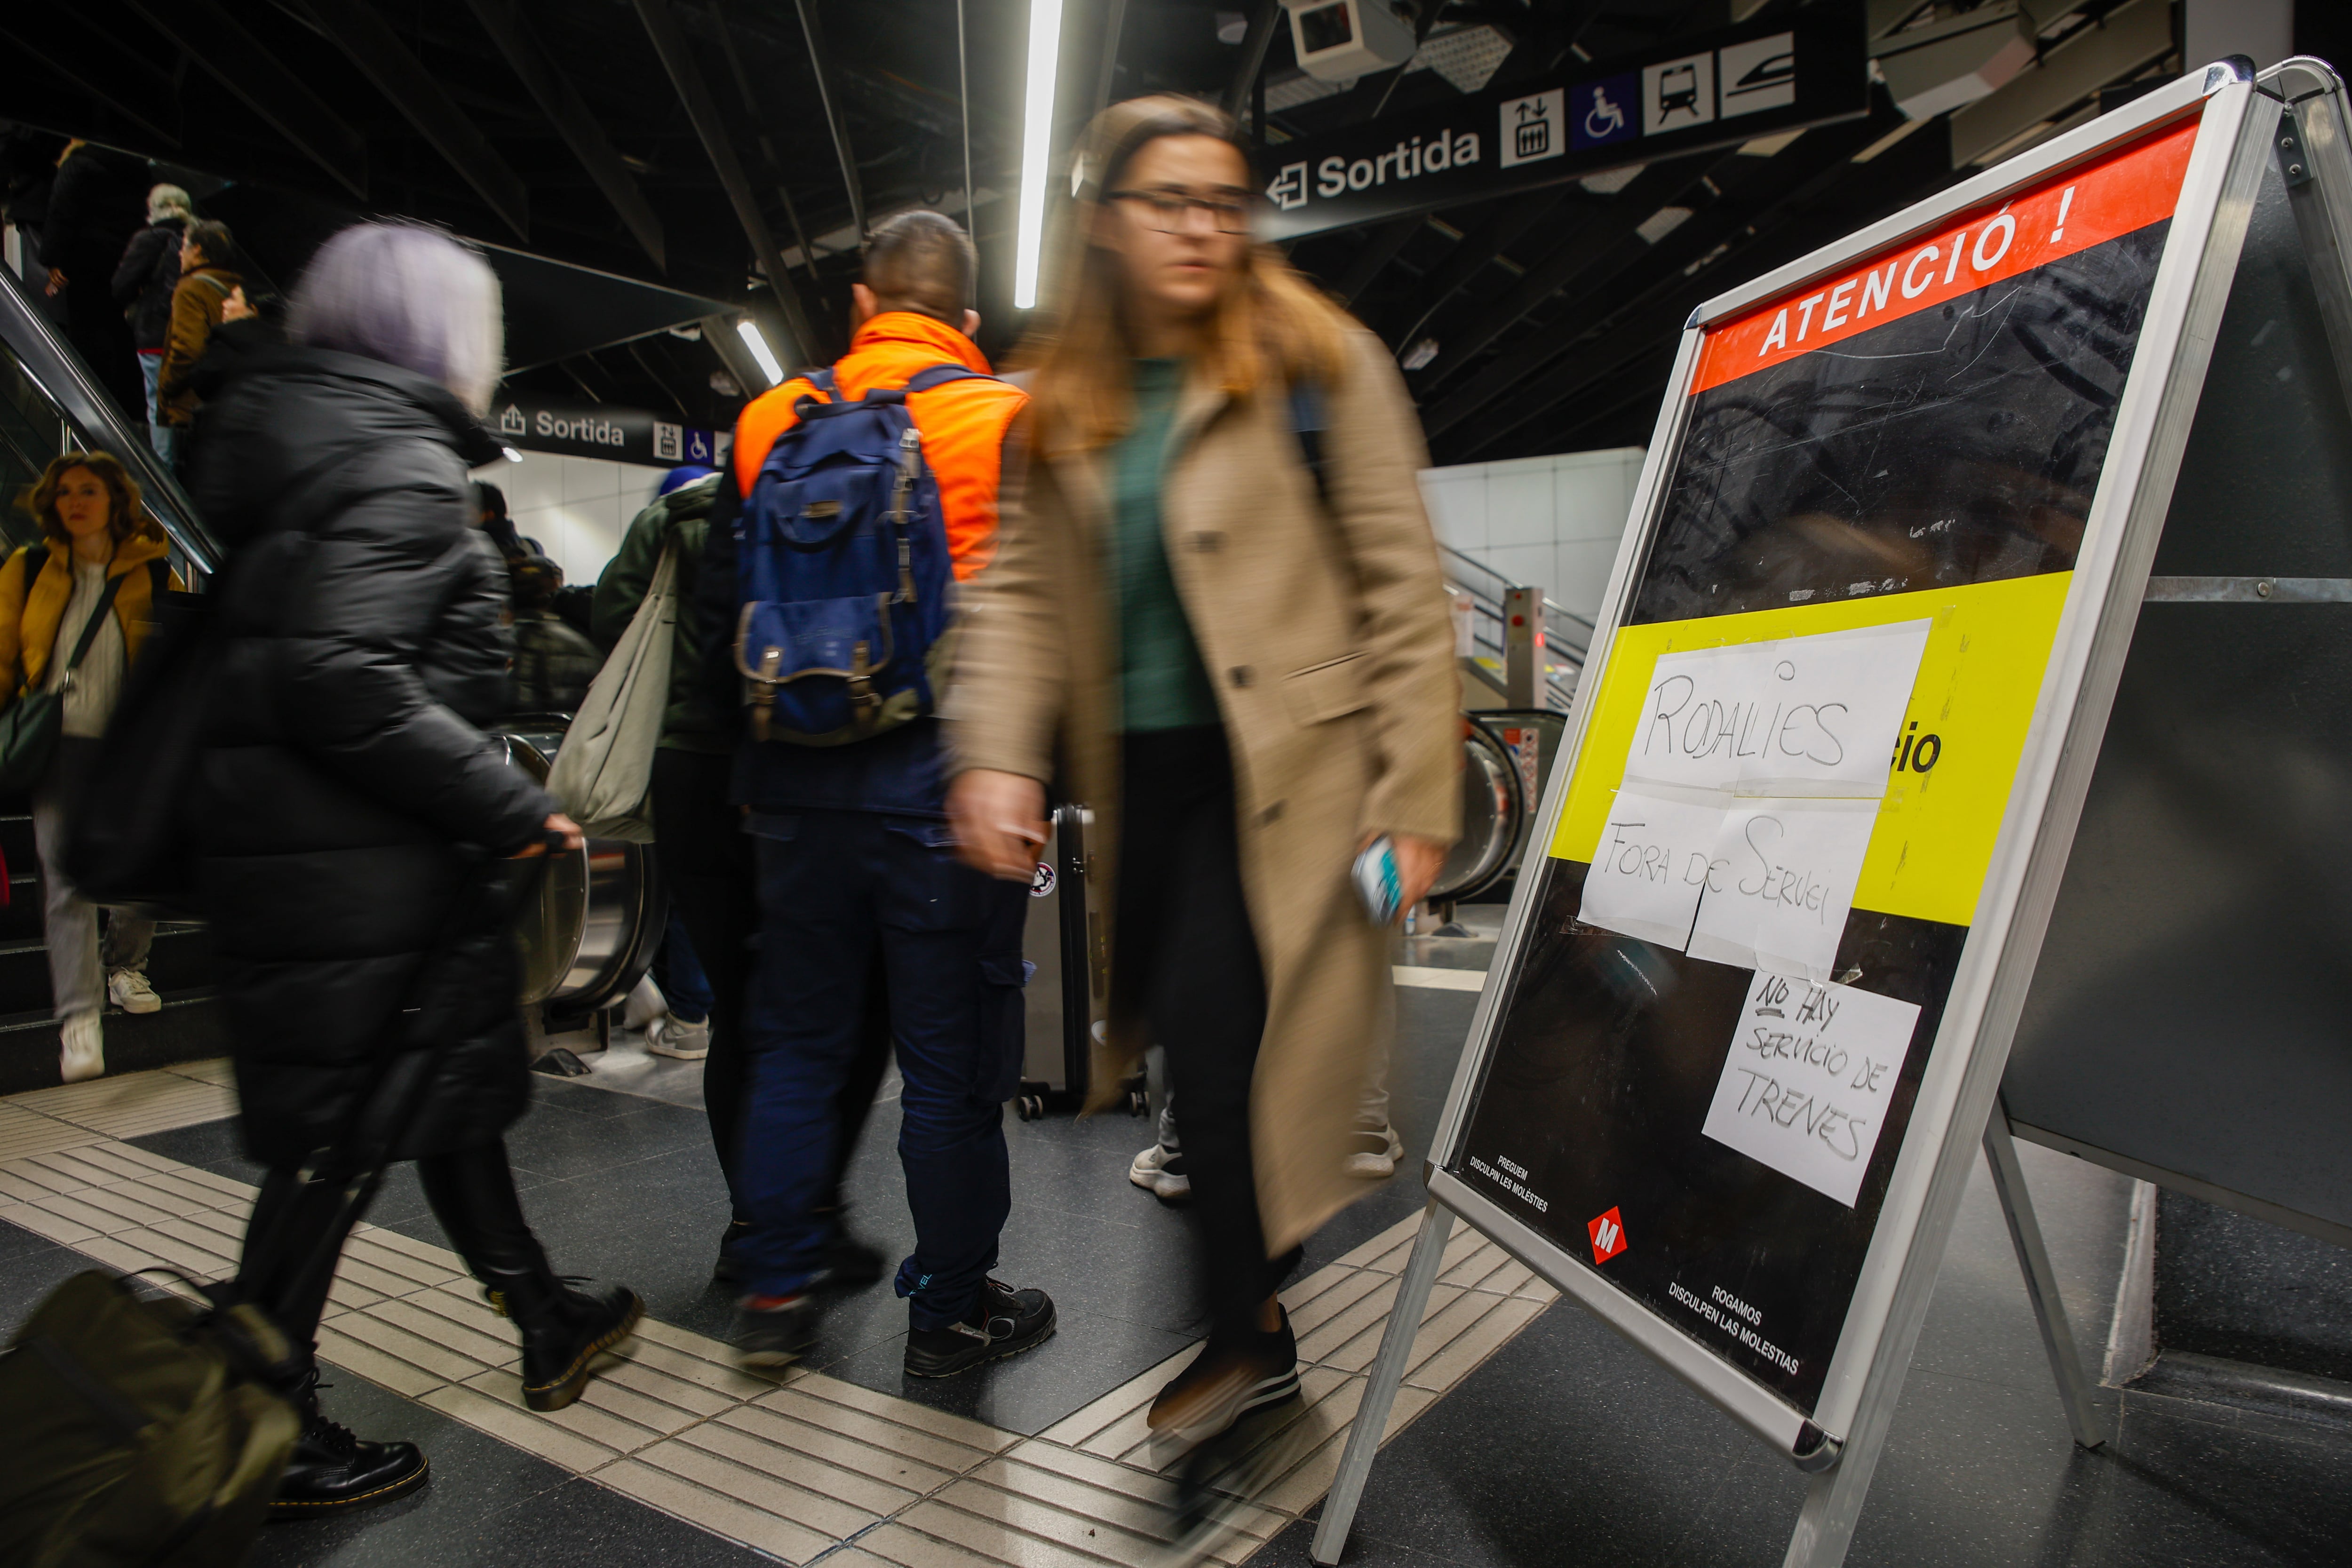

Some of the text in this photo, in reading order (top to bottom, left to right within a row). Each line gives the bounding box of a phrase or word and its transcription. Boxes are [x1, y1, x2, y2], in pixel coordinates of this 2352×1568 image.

[1318, 128, 1480, 198] Sortida
[1758, 185, 2075, 357] ATENCIÓ !
[536, 410, 625, 447] Sortida
[1891, 721, 1941, 773] io
[1684, 852, 1730, 893] DE
[1756, 975, 1839, 1032] NO HAY
[1850, 1057, 1888, 1092] DE
[1737, 1067, 1867, 1161] TRENES
[1470, 1155, 1548, 1213] DISCULPIN LES MOLÈSTIES
[1497, 1154, 1528, 1181] PREGUEM
[1594, 1217, 1620, 1254] M
[1668, 1281, 1799, 1376] DISCULPEN LAS MOLESTIAS
[1711, 1285, 1762, 1326] ROGAMOS
